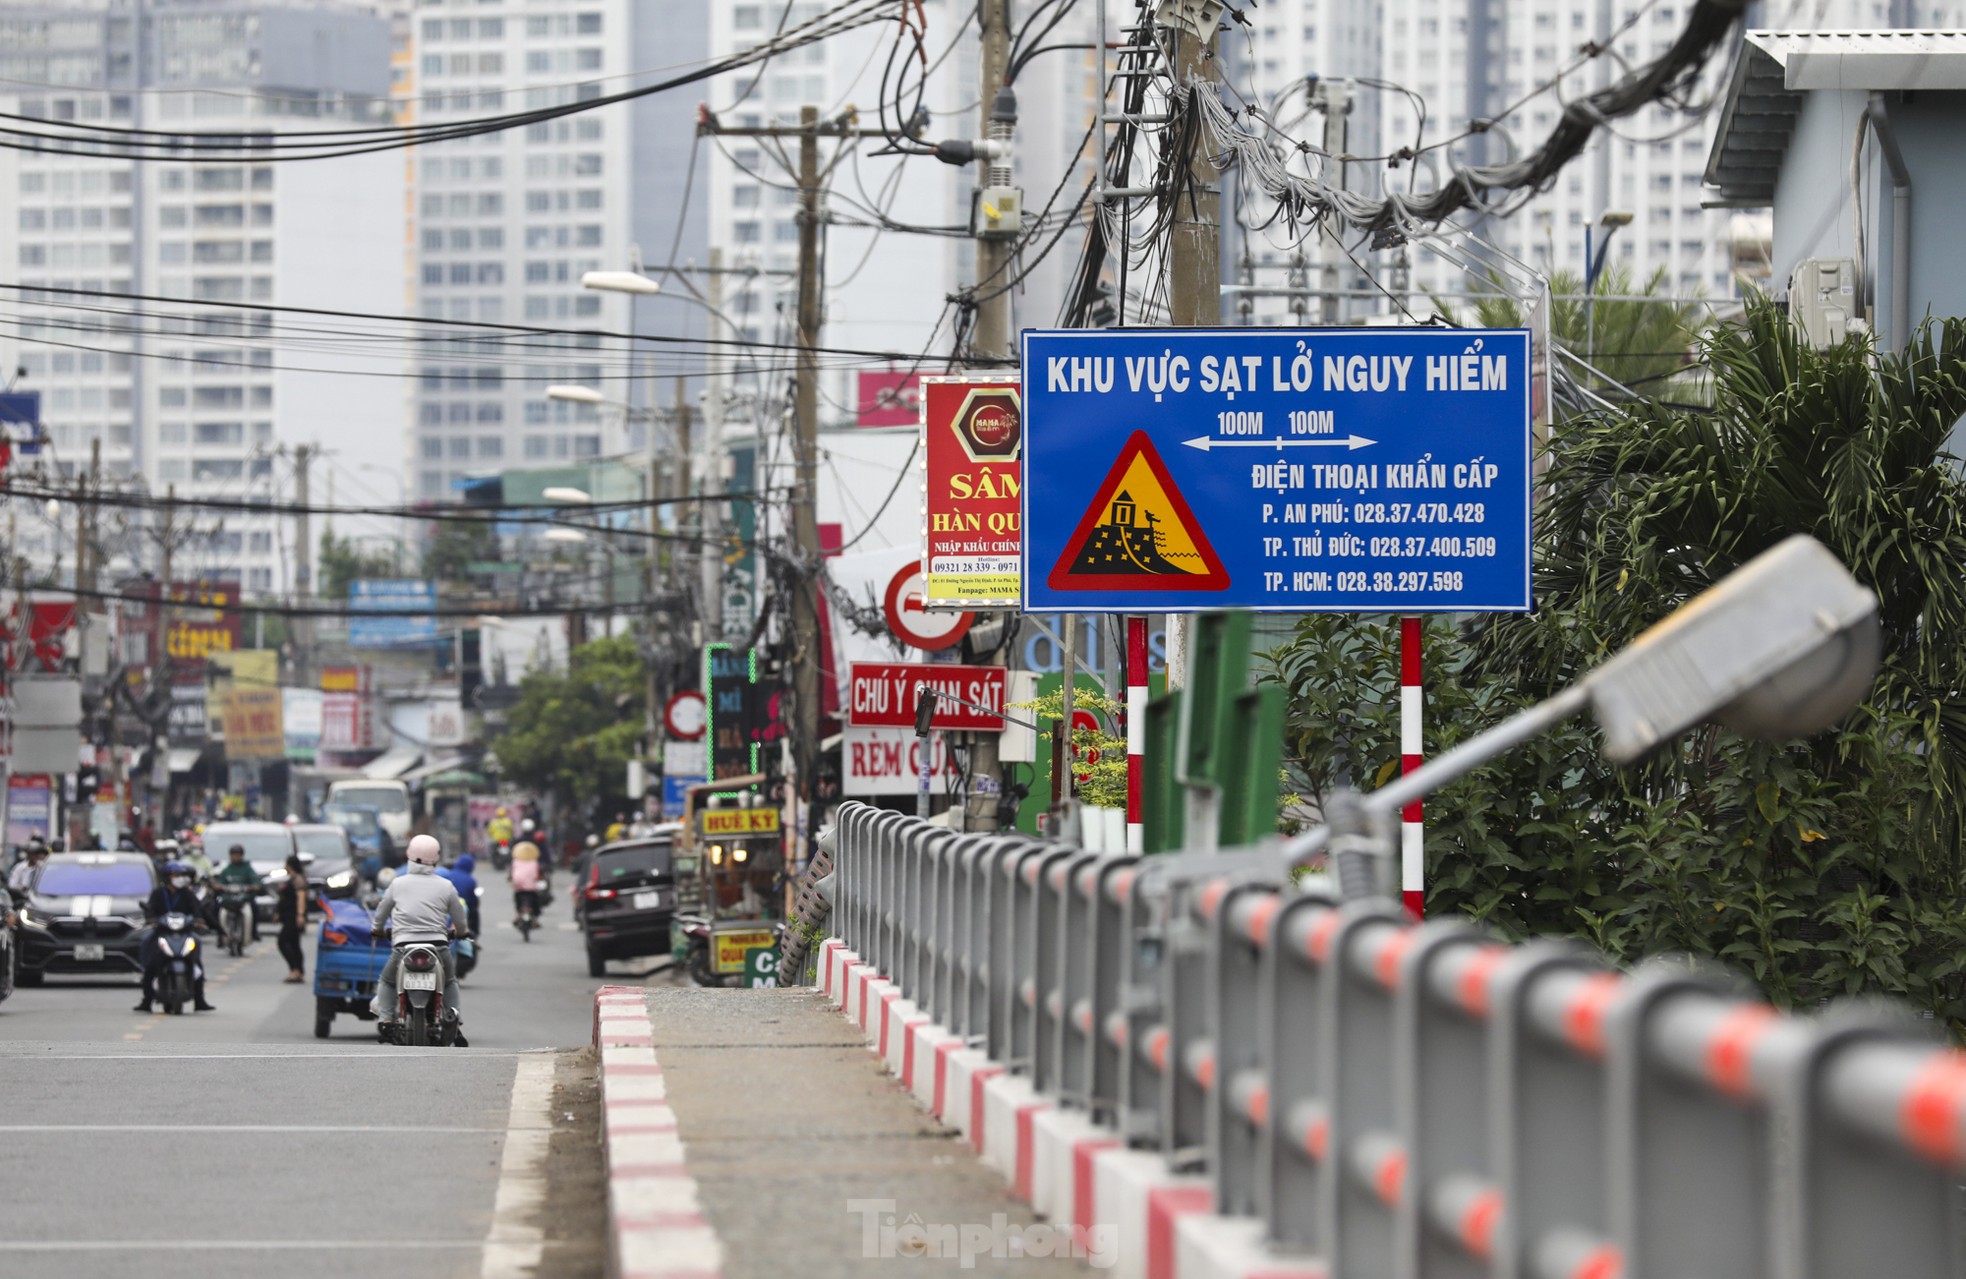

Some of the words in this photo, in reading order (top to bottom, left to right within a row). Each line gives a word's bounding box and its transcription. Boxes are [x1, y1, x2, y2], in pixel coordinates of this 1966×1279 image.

[1047, 356, 1115, 393] KHU
[1125, 349, 1191, 402] VỰC
[1200, 356, 1262, 400] SẠT
[1273, 340, 1313, 392] LỞ
[1323, 355, 1414, 392] NGUY
[1426, 338, 1507, 391] HIỂM
[1217, 411, 1263, 435] 100M
[1288, 410, 1334, 434] 100M
[1251, 460, 1305, 495] ĐIỆN
[1311, 464, 1377, 495] THOẠI
[1386, 452, 1446, 489] KHẨN
[1453, 455, 1499, 489] CẤP
[932, 507, 981, 532] HÀN
[1262, 503, 1279, 524] P.
[1284, 503, 1307, 524] AN
[1311, 498, 1349, 524] PHÚ:
[1354, 502, 1485, 524] 028.37.470.428
[935, 539, 961, 555] NHẬP
[963, 537, 989, 552] KHẨU
[1263, 537, 1288, 557] TP.
[1293, 529, 1323, 557] THỦ
[1328, 531, 1366, 557] ĐỨC:
[1370, 536, 1496, 558] 028.37.400.509
[934, 563, 960, 573] 09321
[963, 563, 973, 572] 28
[975, 563, 991, 572] 339
[998, 562, 1018, 572] 0971
[958, 587, 988, 595] Fanpage:
[1263, 571, 1289, 592] TP.
[1293, 571, 1332, 592] HCM:
[1337, 571, 1463, 592] 028.38.297.598
[854, 669, 889, 714] CHÚ
[894, 669, 907, 714] Ý
[968, 672, 1002, 716] SÁT
[852, 731, 901, 778] RÈM
